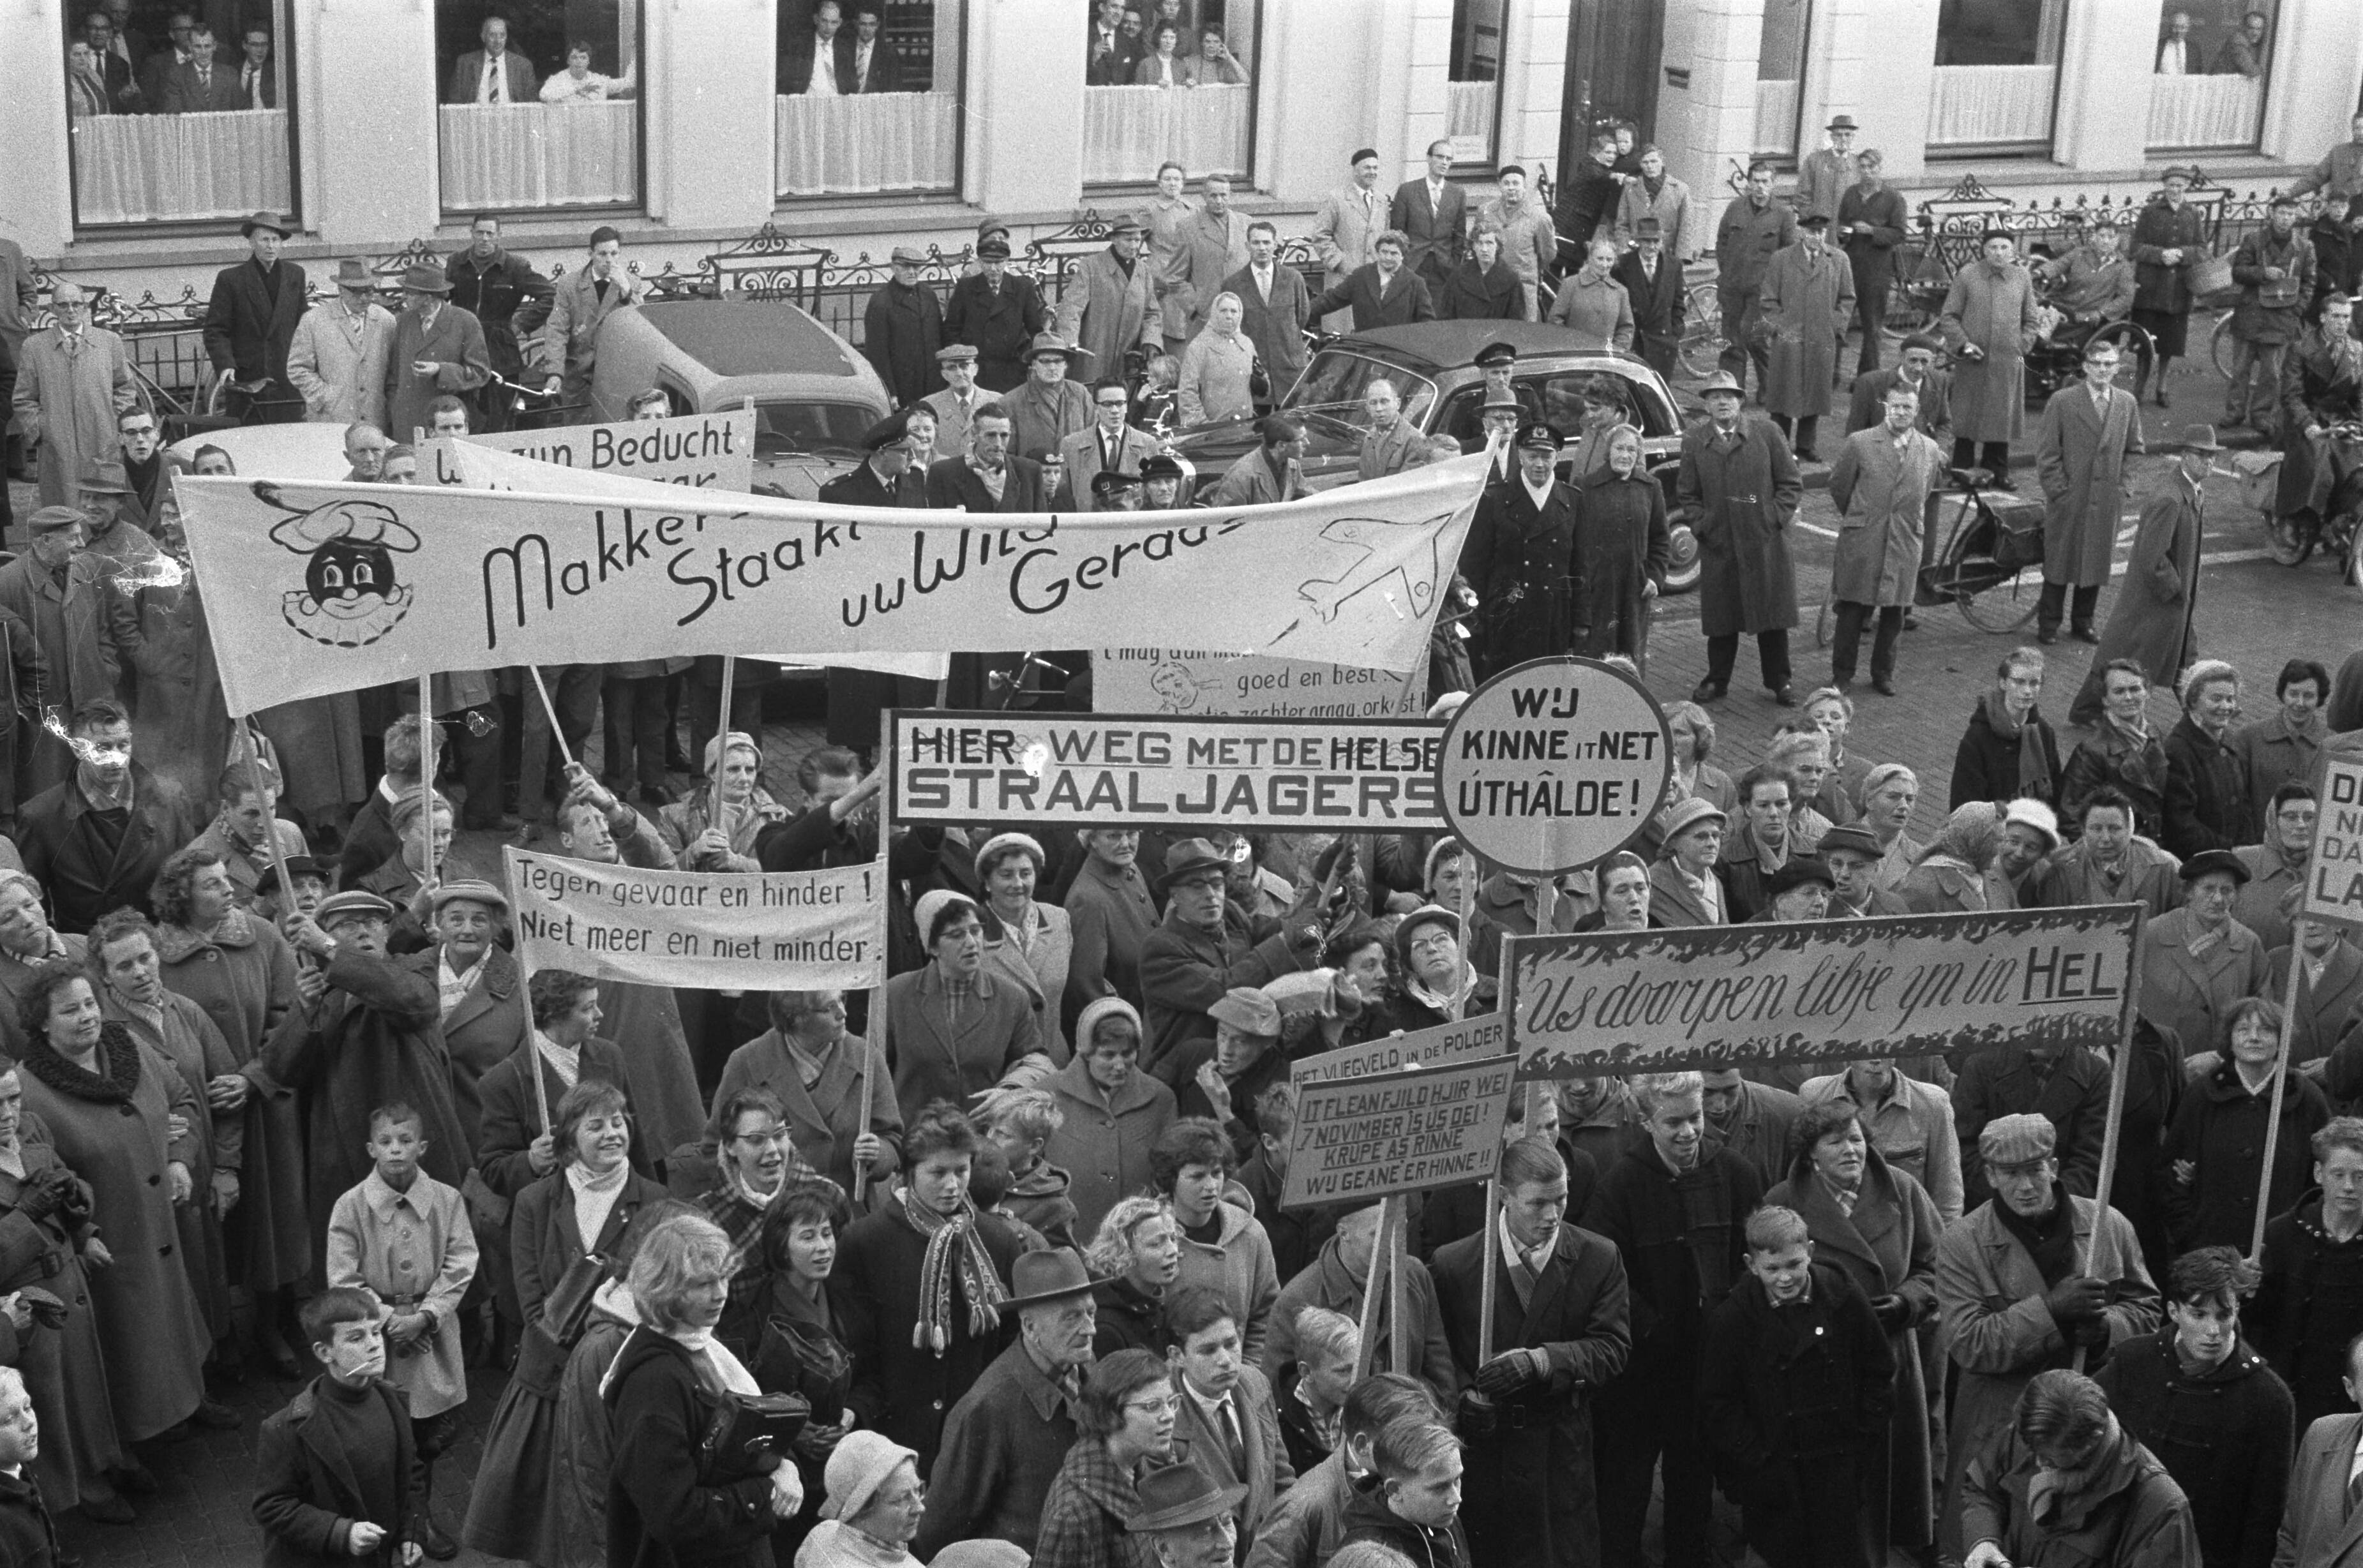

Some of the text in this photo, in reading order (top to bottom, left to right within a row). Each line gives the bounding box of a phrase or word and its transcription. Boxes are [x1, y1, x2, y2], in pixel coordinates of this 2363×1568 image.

[591, 419, 734, 469] Beducht
[483, 509, 749, 650] Makker
[843, 578, 904, 627] uw
[1238, 666, 1289, 698] goed
[1300, 672, 1321, 687] en
[1049, 729, 1171, 765] WEG
[1187, 737, 1268, 765] MET
[1273, 738, 1323, 765] DE
[1330, 736, 1442, 772] HELSE
[1462, 730, 1659, 760] KINNE IT NET
[908, 768, 1442, 819] STRAALJAGERS
[2332, 773, 2363, 807] D
[2337, 810, 2363, 835] N
[517, 859, 601, 900] Tegen
[608, 881, 708, 907] gevaar
[719, 885, 748, 907] en
[763, 878, 845, 906] hinder
[520, 910, 575, 946] Niet
[587, 925, 652, 952] meer
[668, 932, 698, 955] en
[713, 934, 761, 959] niet
[1595, 970, 1788, 1040] doarpen
[1794, 951, 1894, 1033] libje
[1889, 962, 1965, 1035] yn
[1962, 953, 2018, 1005] in
[2022, 946, 2118, 1001] HEL
[1406, 1050, 1419, 1064] IN
[1425, 1045, 1440, 1060] DE
[1444, 1024, 1503, 1054] POLDER
[1305, 1100, 1323, 1121] IT
[1430, 1080, 1471, 1104] HJIR
[1477, 1071, 1508, 1096] WEI
[1301, 1128, 1314, 1147] 7
[1315, 1116, 1403, 1147] NOVIMBER
[1425, 1109, 1448, 1129] US
[1387, 1133, 1409, 1158] AS
[1413, 1128, 1464, 1154] RINNE
